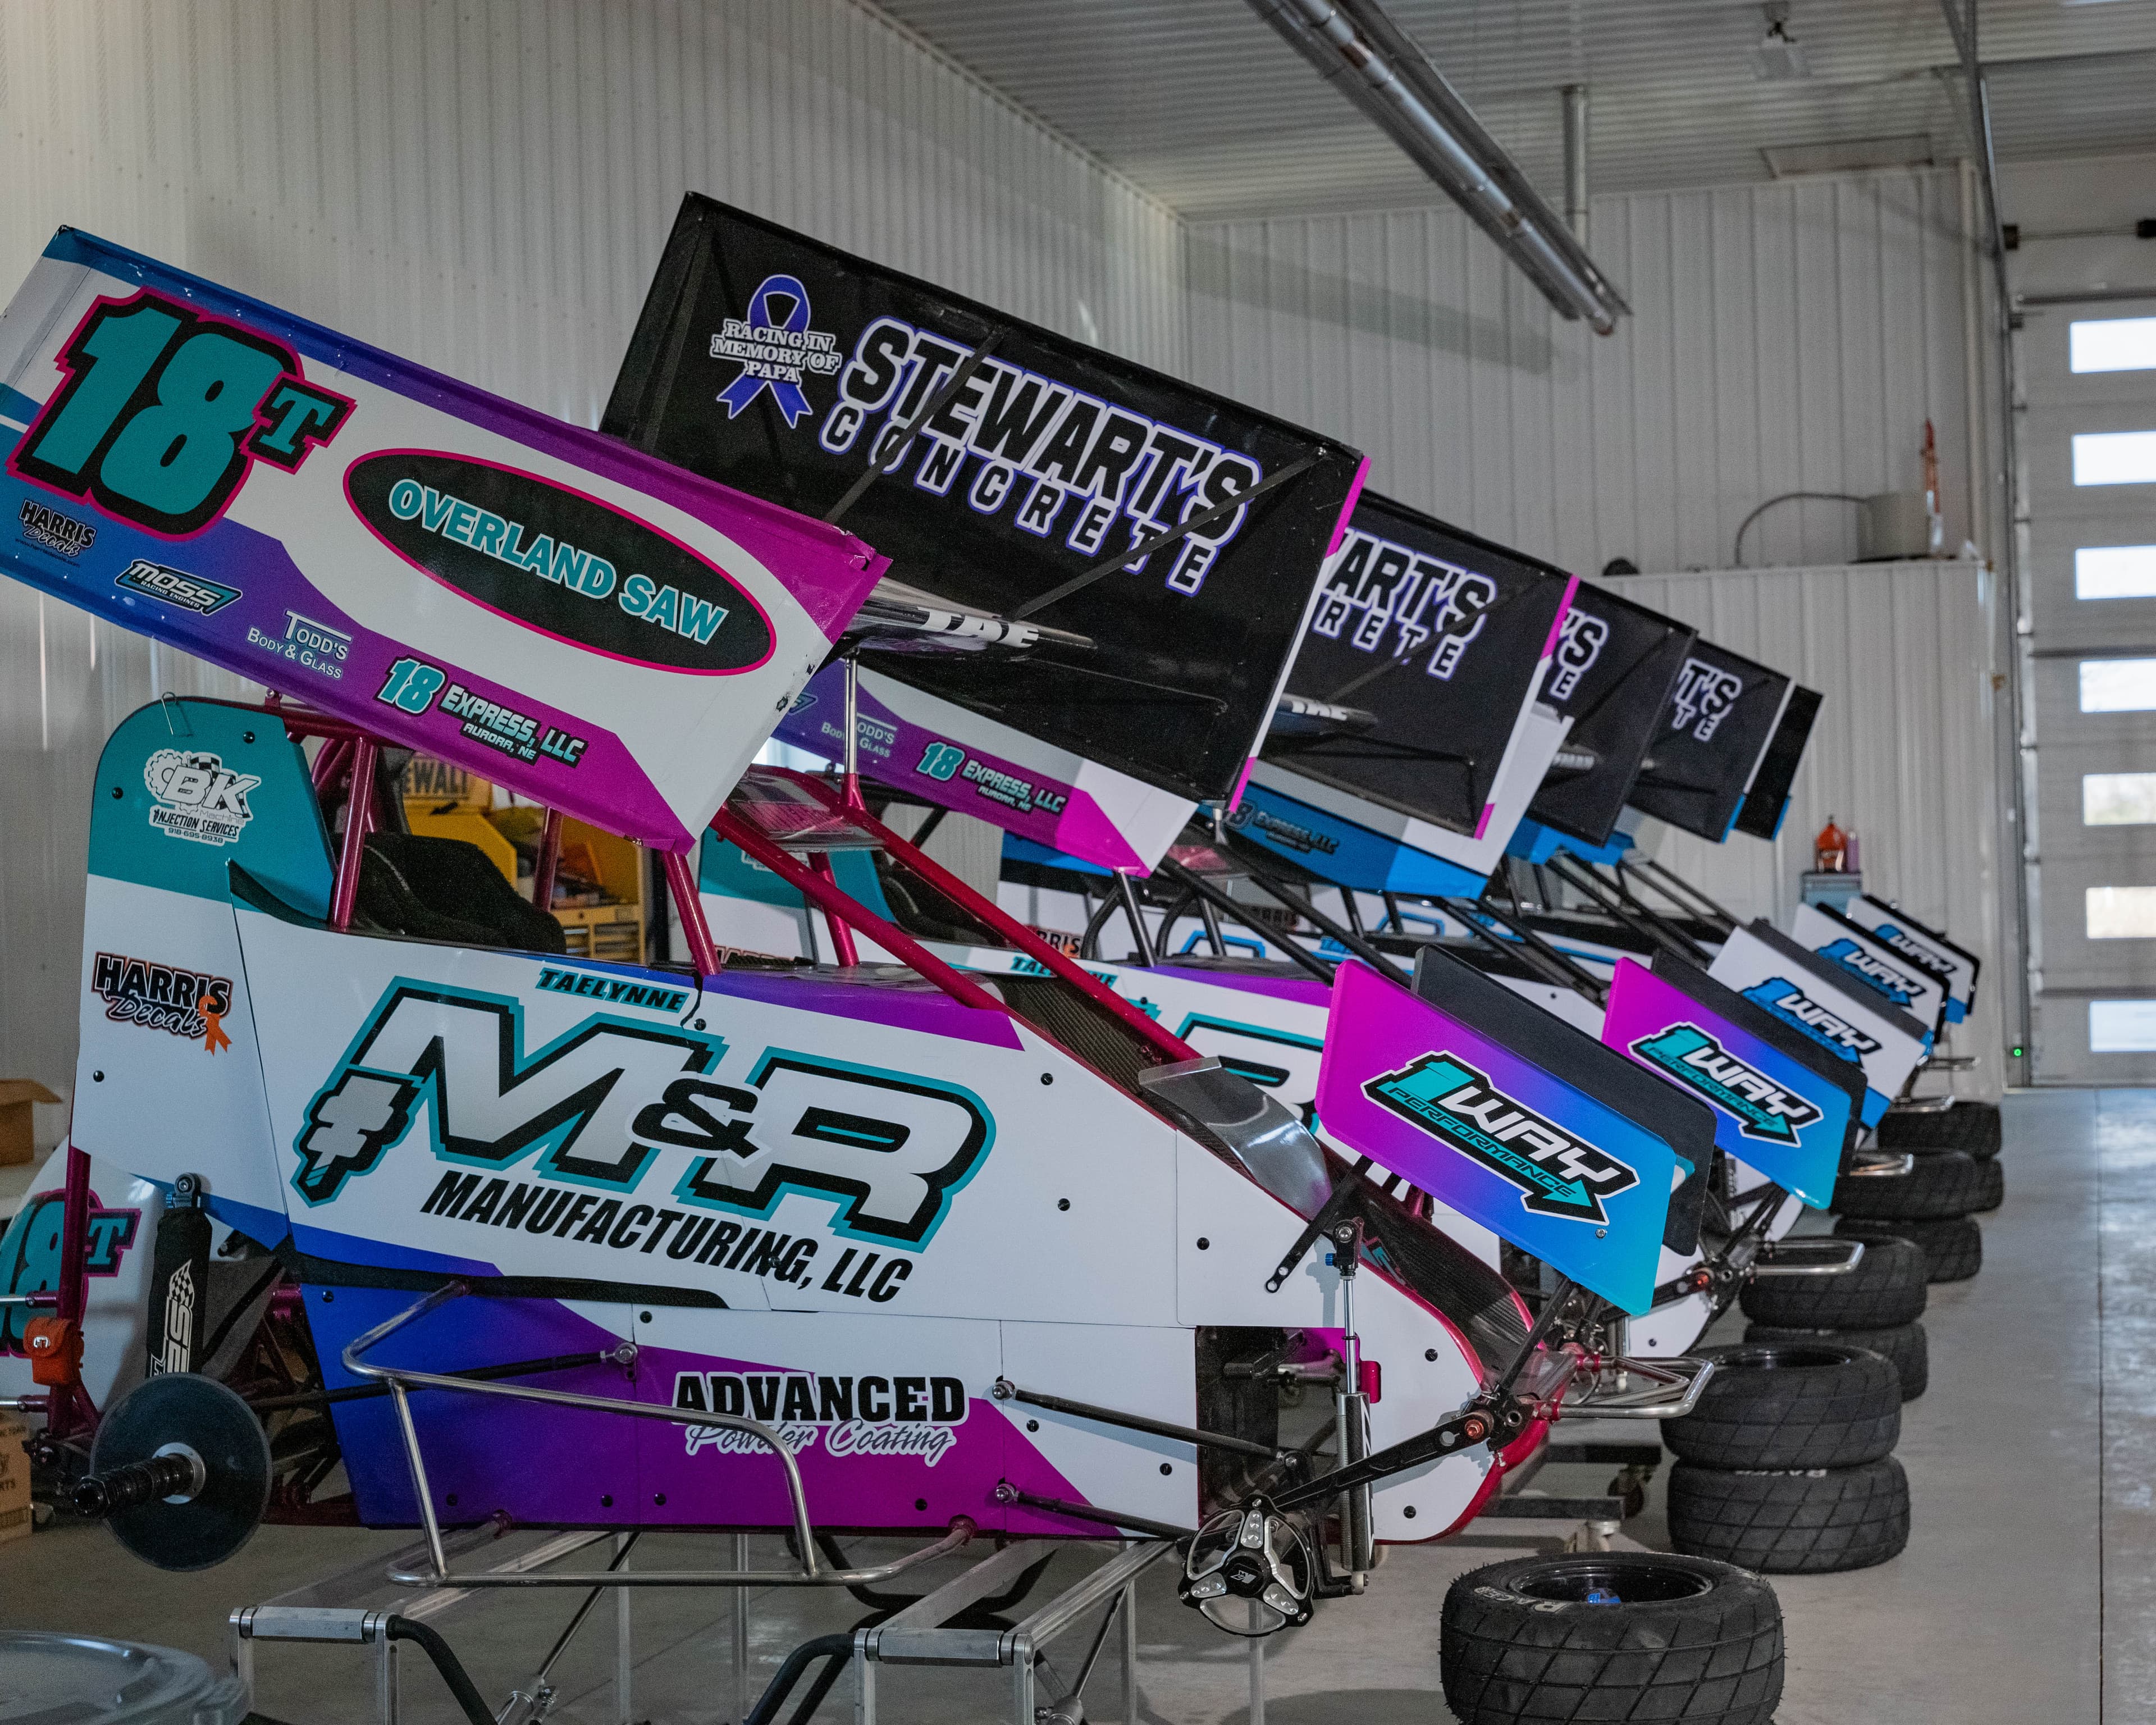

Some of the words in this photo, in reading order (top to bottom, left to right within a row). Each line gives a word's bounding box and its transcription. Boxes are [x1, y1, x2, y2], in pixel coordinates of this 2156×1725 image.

[714, 339, 806, 367] MEMORY
[810, 352, 839, 373] OF
[724, 321, 804, 347] RACING
[807, 332, 833, 353] IN
[746, 360, 800, 384] PAPA
[842, 317, 1260, 542] STEWART'S
[19, 499, 97, 548] HARRIS
[820, 403, 1218, 596] CONCRETE
[24, 522, 80, 557] Decals
[389, 478, 616, 599] OVERLAND
[618, 573, 729, 645] SAW
[128, 563, 221, 606] MOSS
[140, 581, 168, 596] RACING
[169, 592, 200, 608] ENGINES
[1323, 527, 1496, 644] ART'S
[247, 627, 284, 654] BODY
[284, 643, 297, 660] &
[299, 650, 342, 679] GLASS
[285, 610, 352, 660] TODD'S
[377, 658, 446, 714] 18
[440, 684, 539, 747] EXPRESS,
[540, 729, 584, 763] LLC
[856, 712, 897, 745] ODD'S
[463, 723, 515, 754] AURORA,
[518, 746, 537, 760] NE
[161, 765, 259, 815] BK
[916, 742, 965, 782] 18
[962, 760, 1032, 802] EXPRESS,
[1034, 790, 1066, 813] LLC
[199, 820, 239, 837] SERVICES
[200, 809, 245, 825] Machine
[1017, 801, 1031, 812] NE
[94, 955, 230, 1017] HARRIS
[536, 968, 688, 1012] TAELYNNE
[104, 989, 208, 1037] Decals
[1647, 1046, 1781, 1126] PERFORMANCE
[1388, 1087, 1579, 1198] PERFORMANCE
[420, 1171, 819, 1290] MANUFACTURING,
[821, 1248, 913, 1303] LLC
[675, 1372, 967, 1425] ADVANCED
[826, 1418, 956, 1467] Coating
